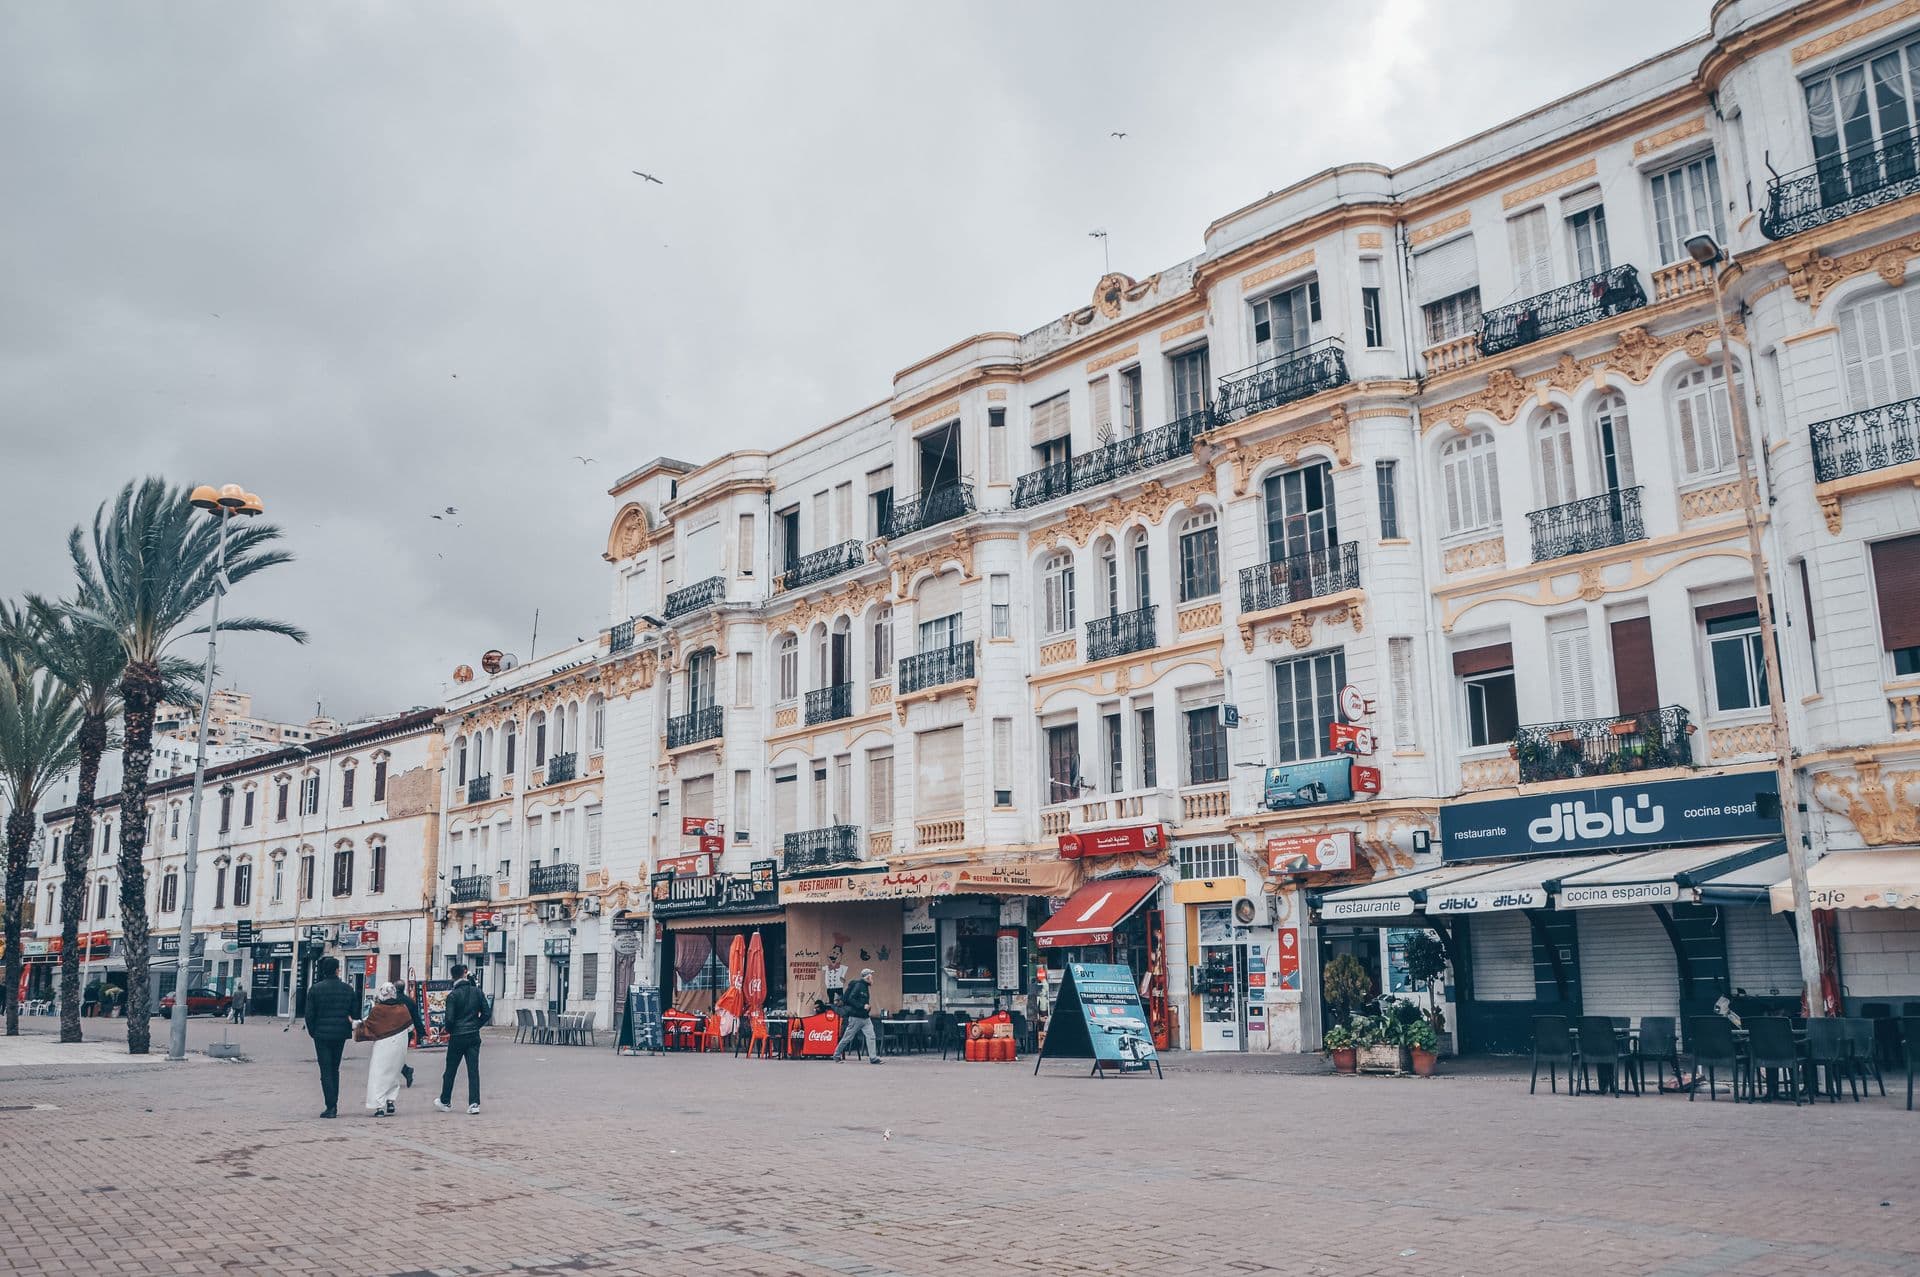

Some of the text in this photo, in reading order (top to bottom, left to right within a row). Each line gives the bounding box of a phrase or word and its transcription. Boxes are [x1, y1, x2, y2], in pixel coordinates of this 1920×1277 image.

[1274, 774, 1290, 784] BVT
[1454, 826, 1507, 840] restaurante
[1683, 806, 1721, 818] cocina
[671, 877, 716, 900] NAHDA
[798, 878, 843, 892] RESTAURANT
[1567, 884, 1671, 901] cocina española
[1334, 899, 1401, 914] restaurante
[808, 1029, 834, 1042] Coca-Cola
